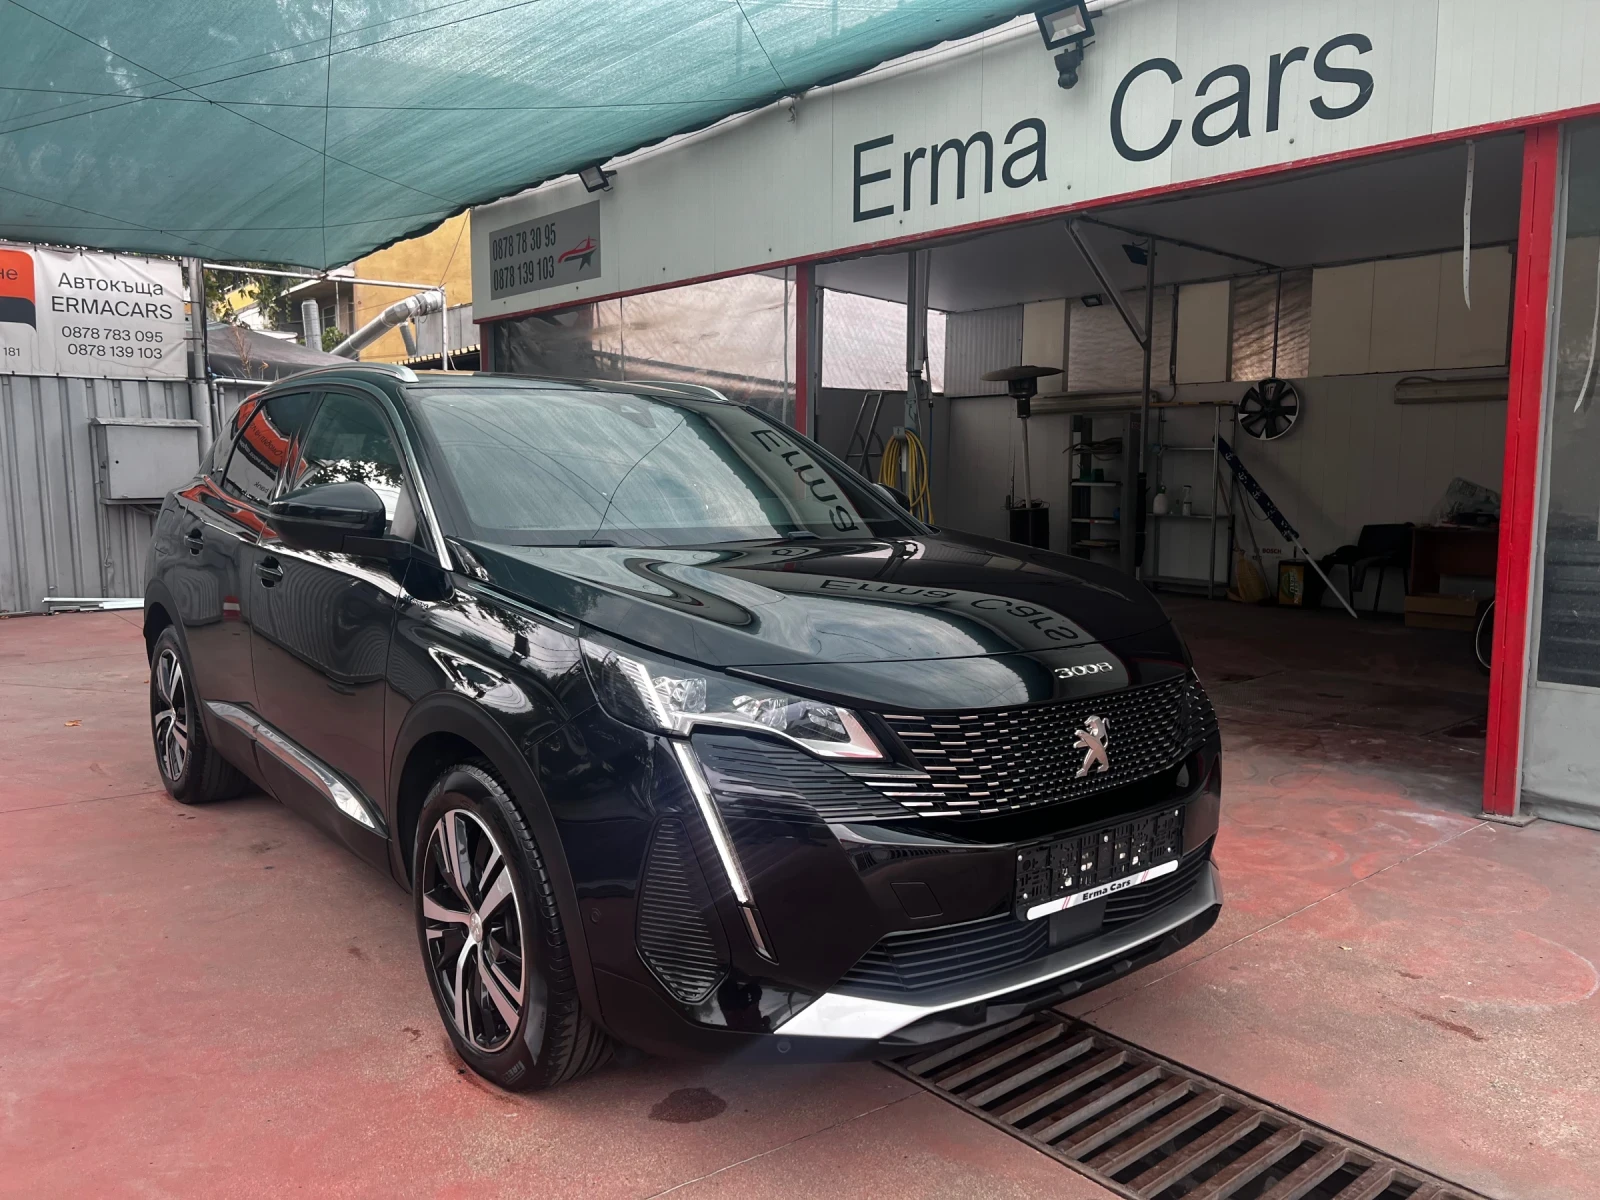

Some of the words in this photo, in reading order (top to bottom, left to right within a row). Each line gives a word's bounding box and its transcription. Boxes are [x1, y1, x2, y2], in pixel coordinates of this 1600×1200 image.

[853, 117, 1048, 223] Erma
[1110, 33, 1374, 162] Cars
[492, 235, 514, 261] 0878
[516, 231, 528, 254] 78
[530, 227, 542, 251] 30
[544, 222, 556, 247] 95
[493, 265, 515, 291] 0878
[517, 260, 535, 285] 139
[537, 255, 555, 280] 103
[58, 272, 164, 297] Автокъща
[52, 296, 173, 319] ERMACARS
[62, 326, 100, 339] 0878
[104, 329, 131, 341] 783
[135, 331, 163, 343] 095
[3, 347, 20, 356] 181
[68, 344, 106, 356] 0878
[110, 346, 134, 358] 139
[138, 348, 163, 360] 103
[1054, 661, 1113, 679] 3008
[1082, 888, 1108, 901] Erma
[1110, 880, 1131, 891] Cars
